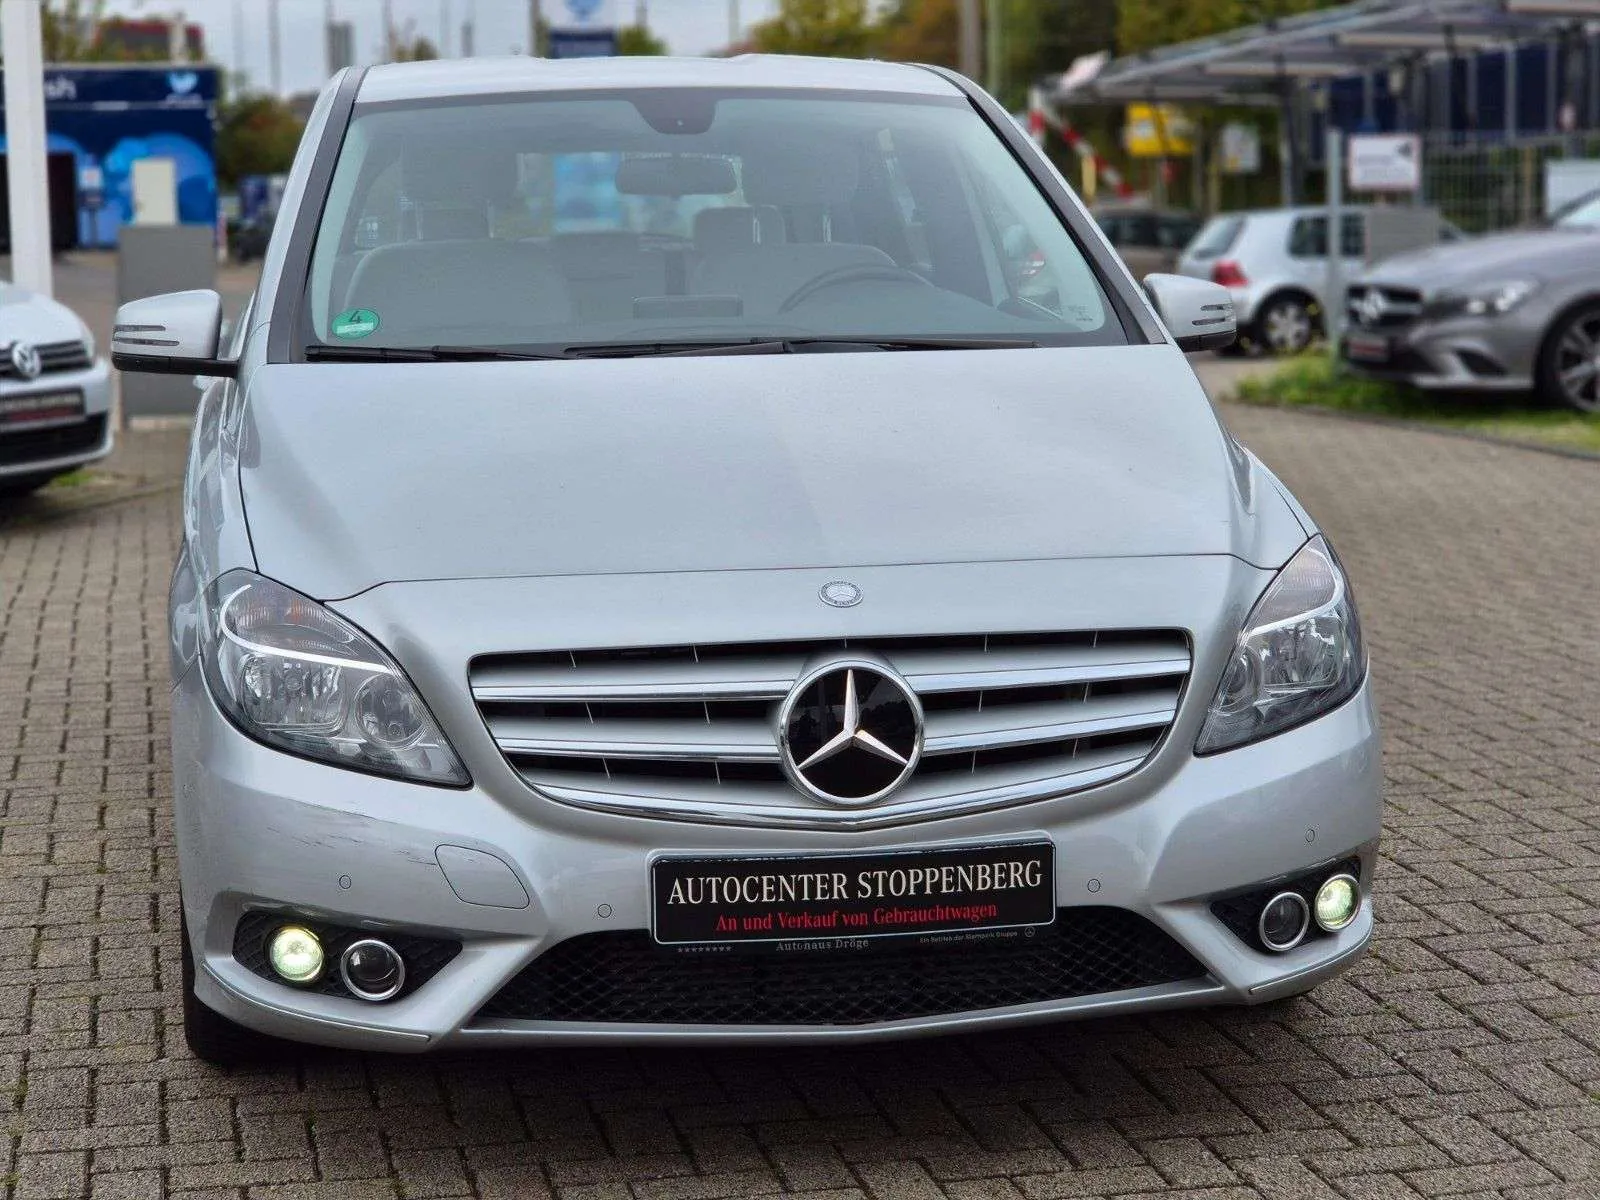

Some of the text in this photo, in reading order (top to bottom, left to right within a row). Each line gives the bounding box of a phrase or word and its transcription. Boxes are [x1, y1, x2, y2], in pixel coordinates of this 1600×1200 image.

[349, 310, 363, 324] 4
[666, 859, 1043, 905] AUTOCENTER STOPPENBERG
[716, 903, 999, 932] An und Verkauf von Gebrauchtwagen
